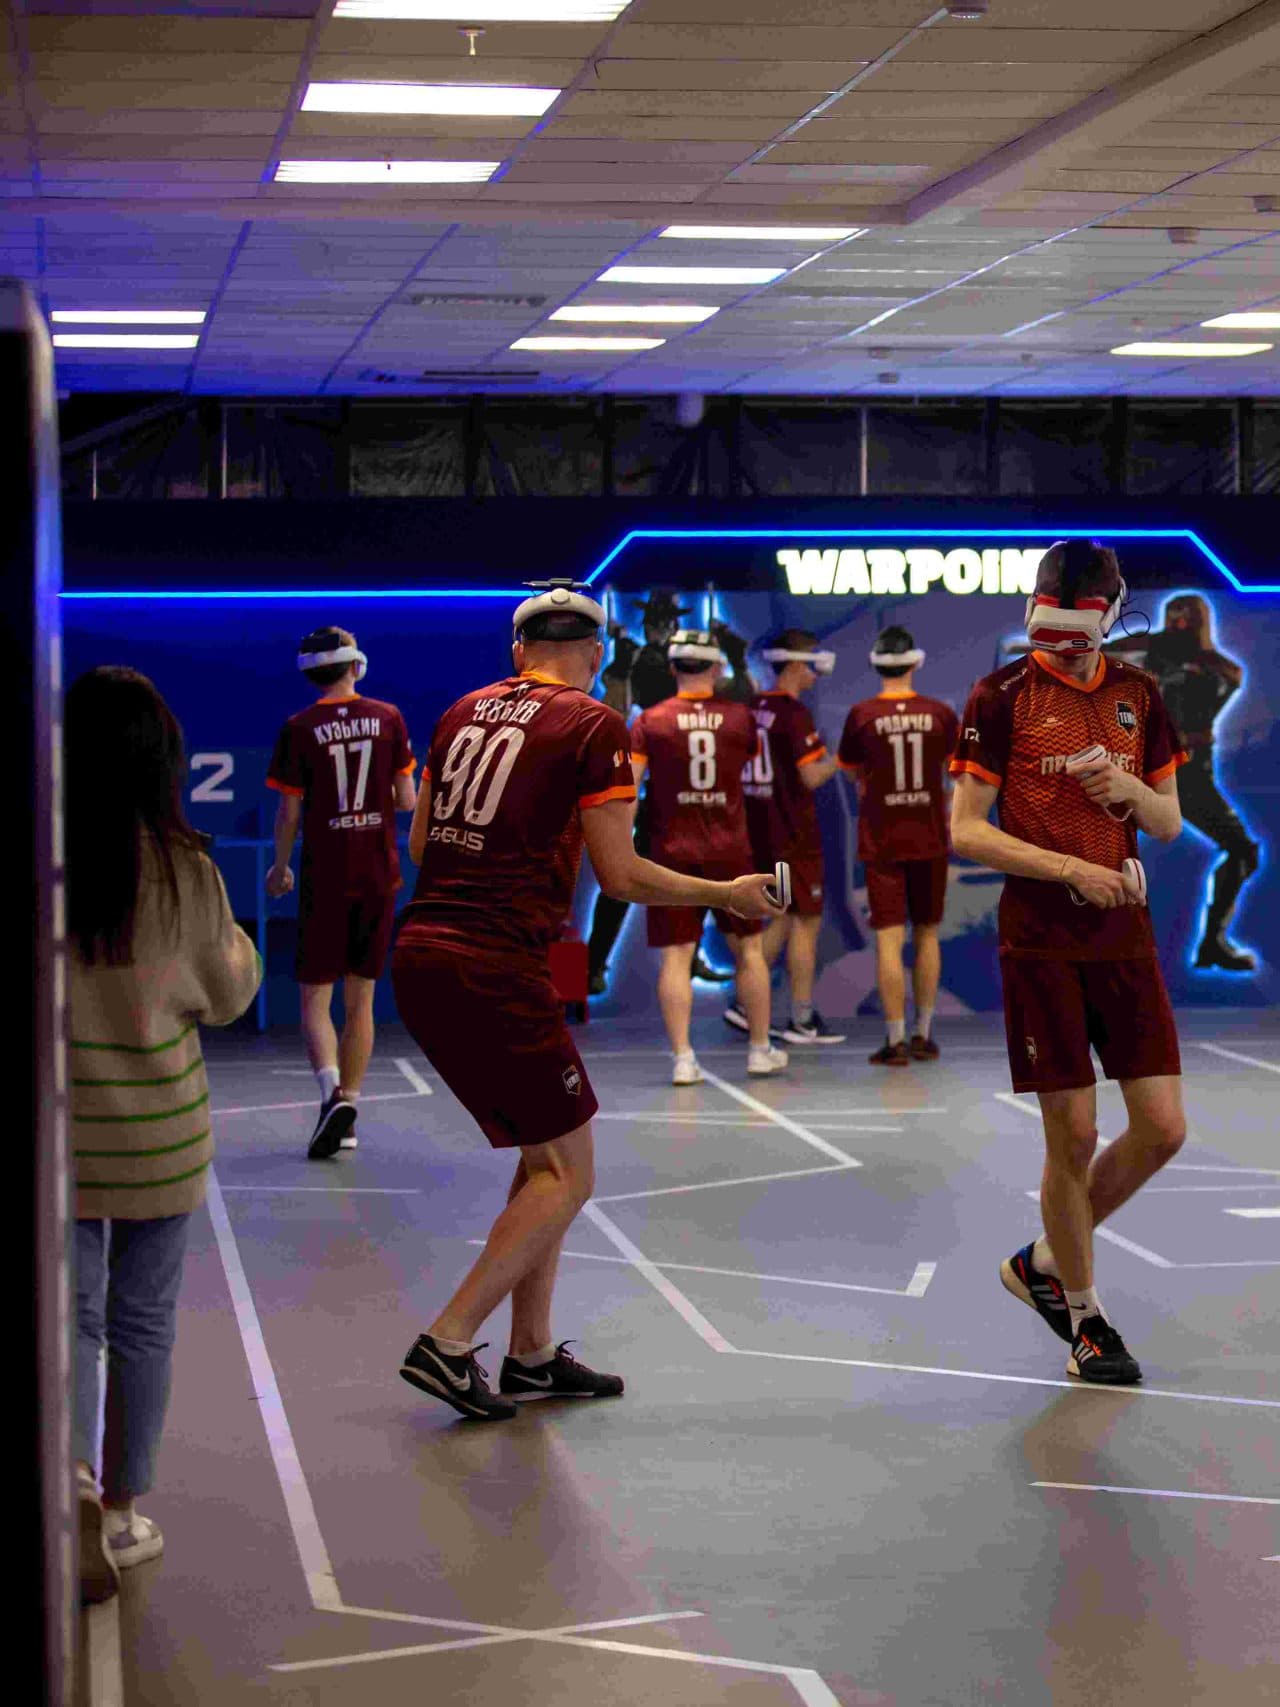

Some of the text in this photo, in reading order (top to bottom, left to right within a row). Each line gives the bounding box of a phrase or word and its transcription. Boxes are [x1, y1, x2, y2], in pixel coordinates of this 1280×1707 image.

[777, 548, 1050, 594] WARPOIN
[313, 717, 380, 744] КУЗЬКИН
[190, 752, 234, 802] 2
[328, 739, 372, 813] 17
[434, 725, 525, 826] 90
[688, 730, 716, 790] 8
[888, 732, 923, 791] 11
[328, 812, 382, 830] SEUS
[427, 826, 485, 851] SEUS
